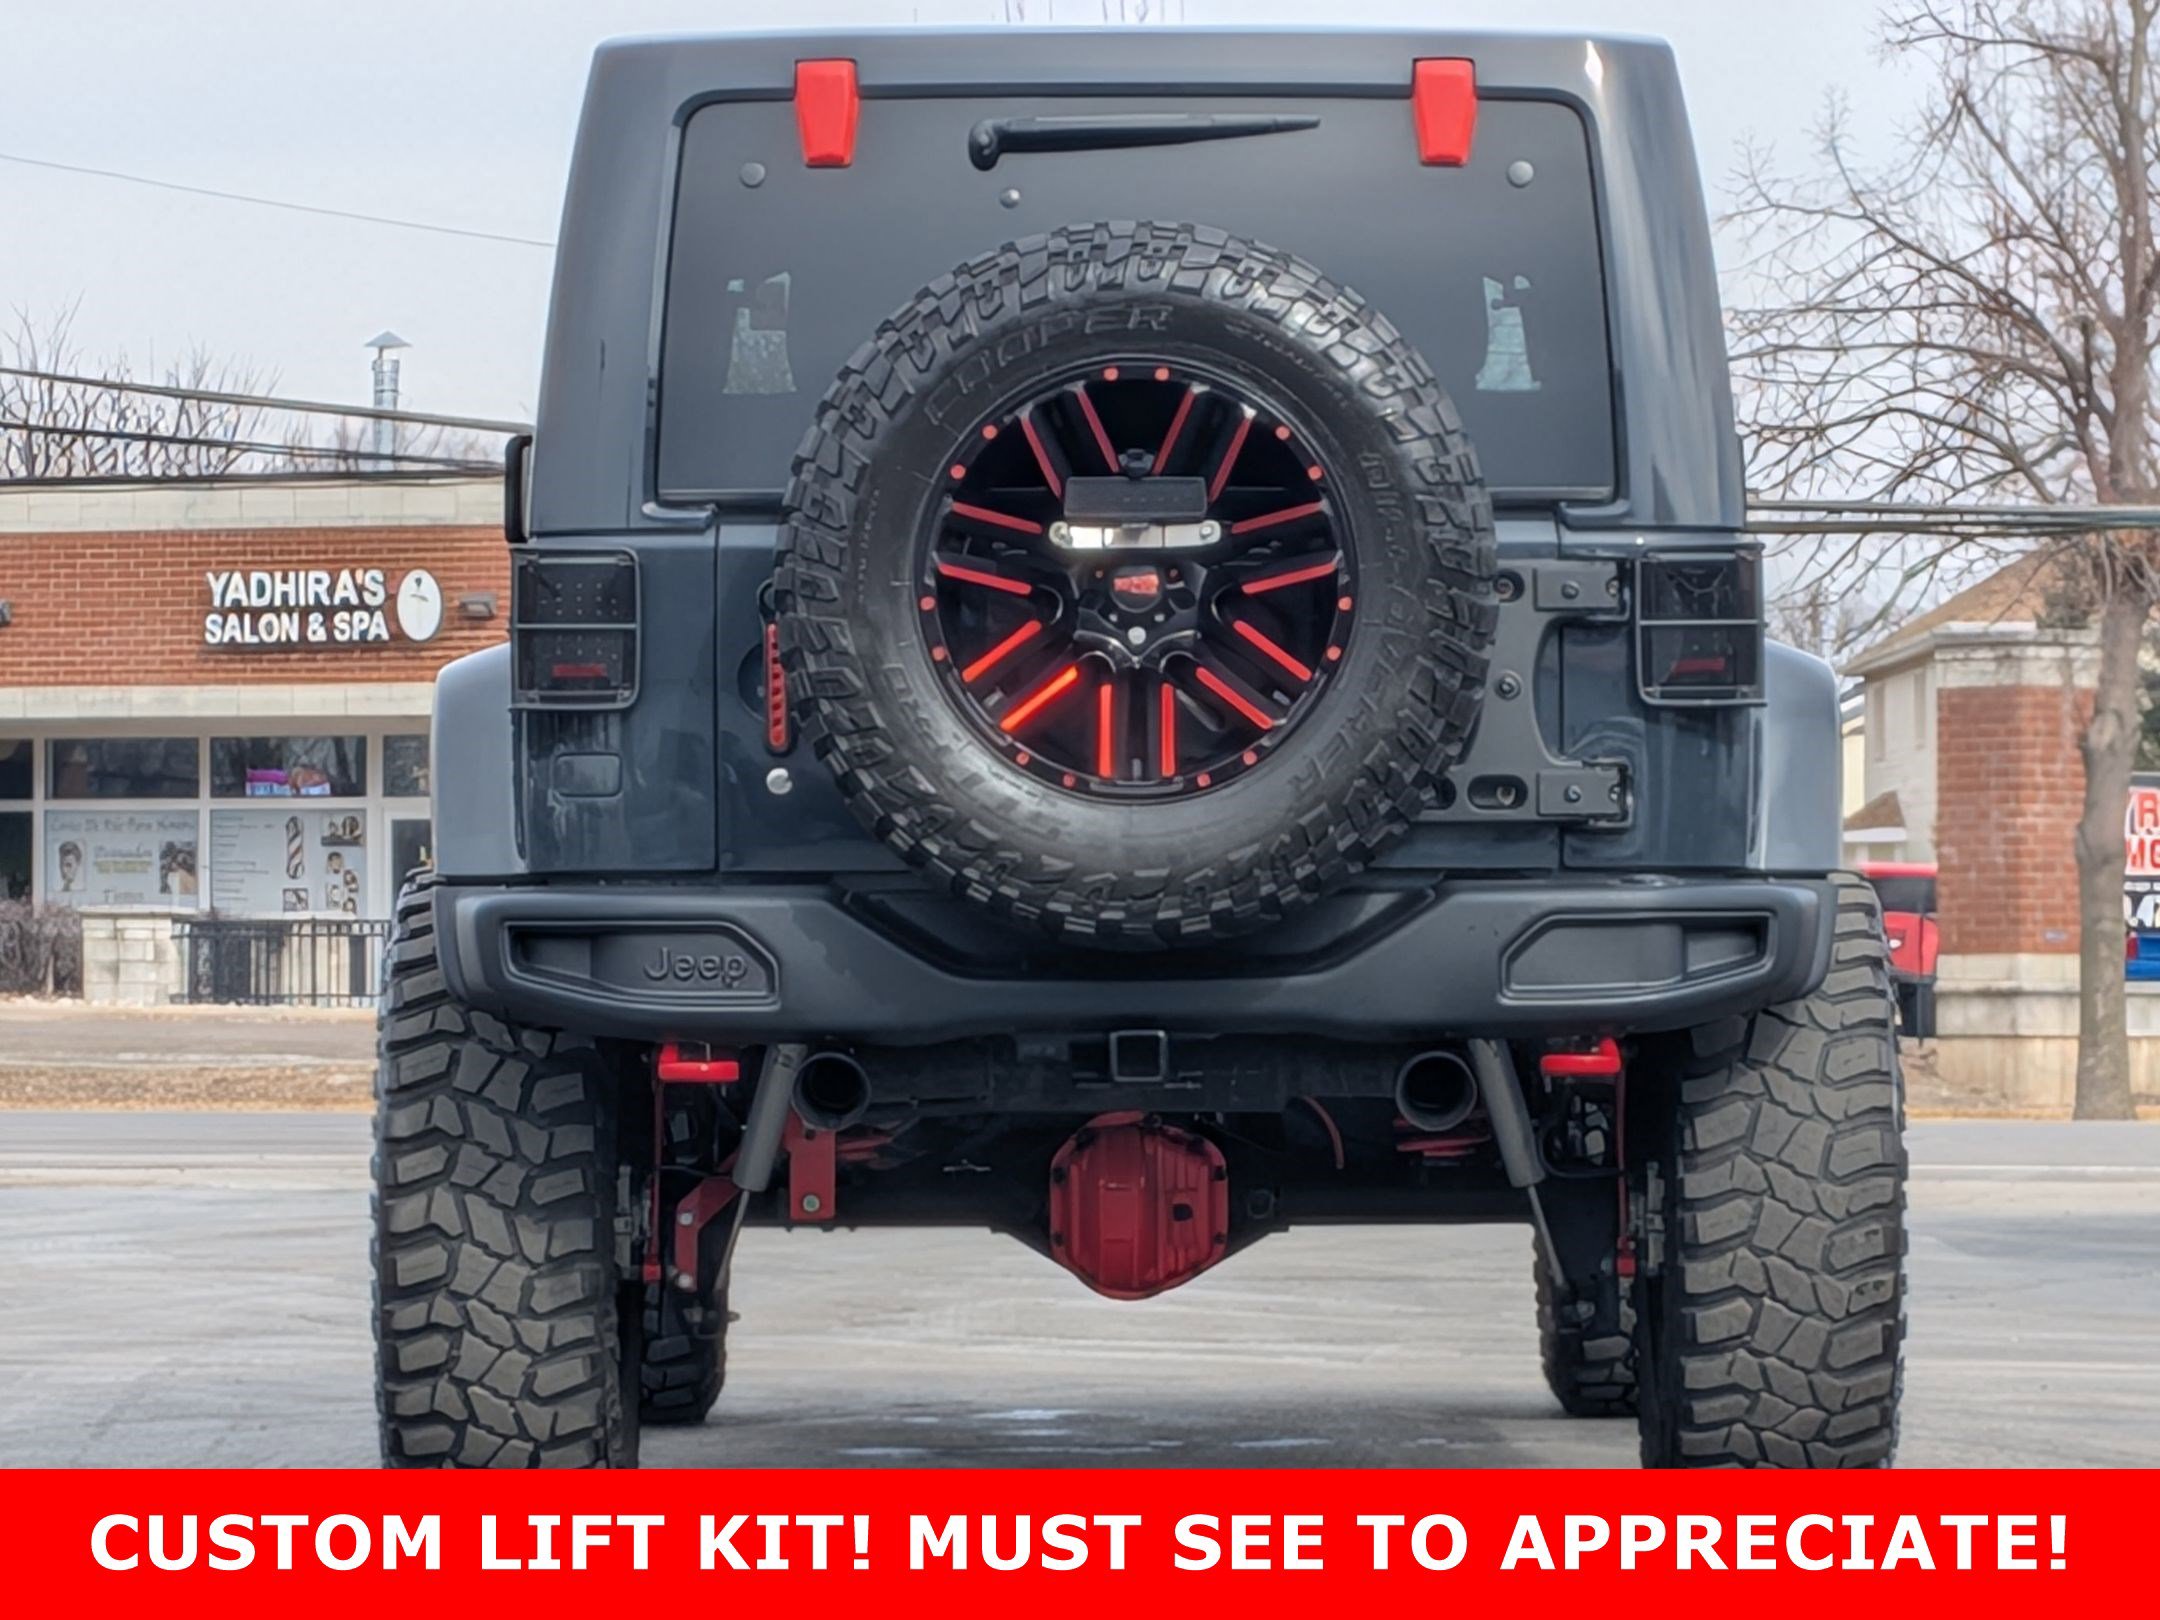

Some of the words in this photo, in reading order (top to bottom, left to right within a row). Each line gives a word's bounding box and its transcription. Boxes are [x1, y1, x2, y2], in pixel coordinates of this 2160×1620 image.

[924, 303, 1174, 425] COOPER
[206, 569, 387, 608] YADHIRA'S
[204, 612, 300, 644] SALON
[307, 612, 328, 643] &
[333, 610, 390, 643] SPA
[643, 946, 748, 988] Jeep
